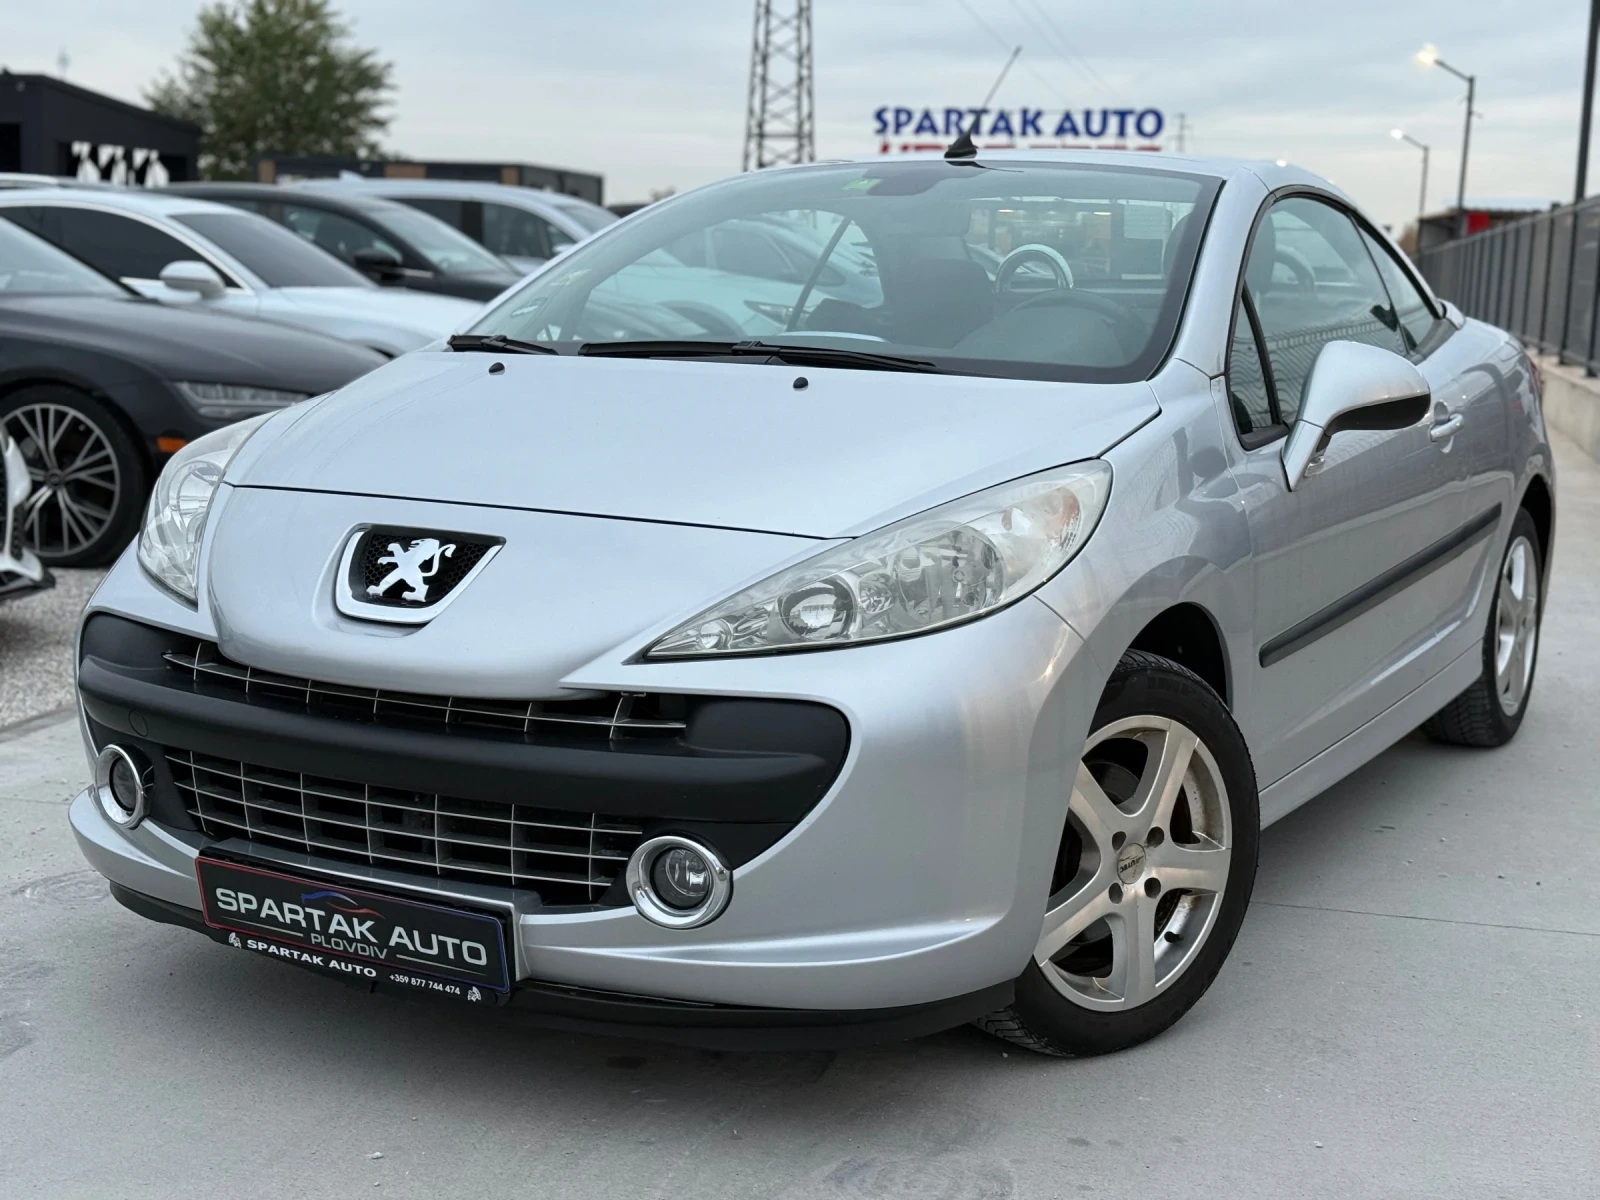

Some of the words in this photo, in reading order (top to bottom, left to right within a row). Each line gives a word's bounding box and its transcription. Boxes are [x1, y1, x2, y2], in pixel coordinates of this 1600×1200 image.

[874, 107, 1043, 137] SPARTAK
[1055, 109, 1164, 138] AUTO
[215, 887, 379, 943] SPARTAK
[388, 926, 487, 966] AUTO
[247, 940, 325, 966] SPARTAK
[328, 959, 377, 978] AUTO
[310, 932, 388, 960] PLOVDIV
[389, 974, 409, 984] +359
[410, 977, 426, 988] 877
[428, 980, 443, 991] 744
[444, 985, 461, 995] 474
